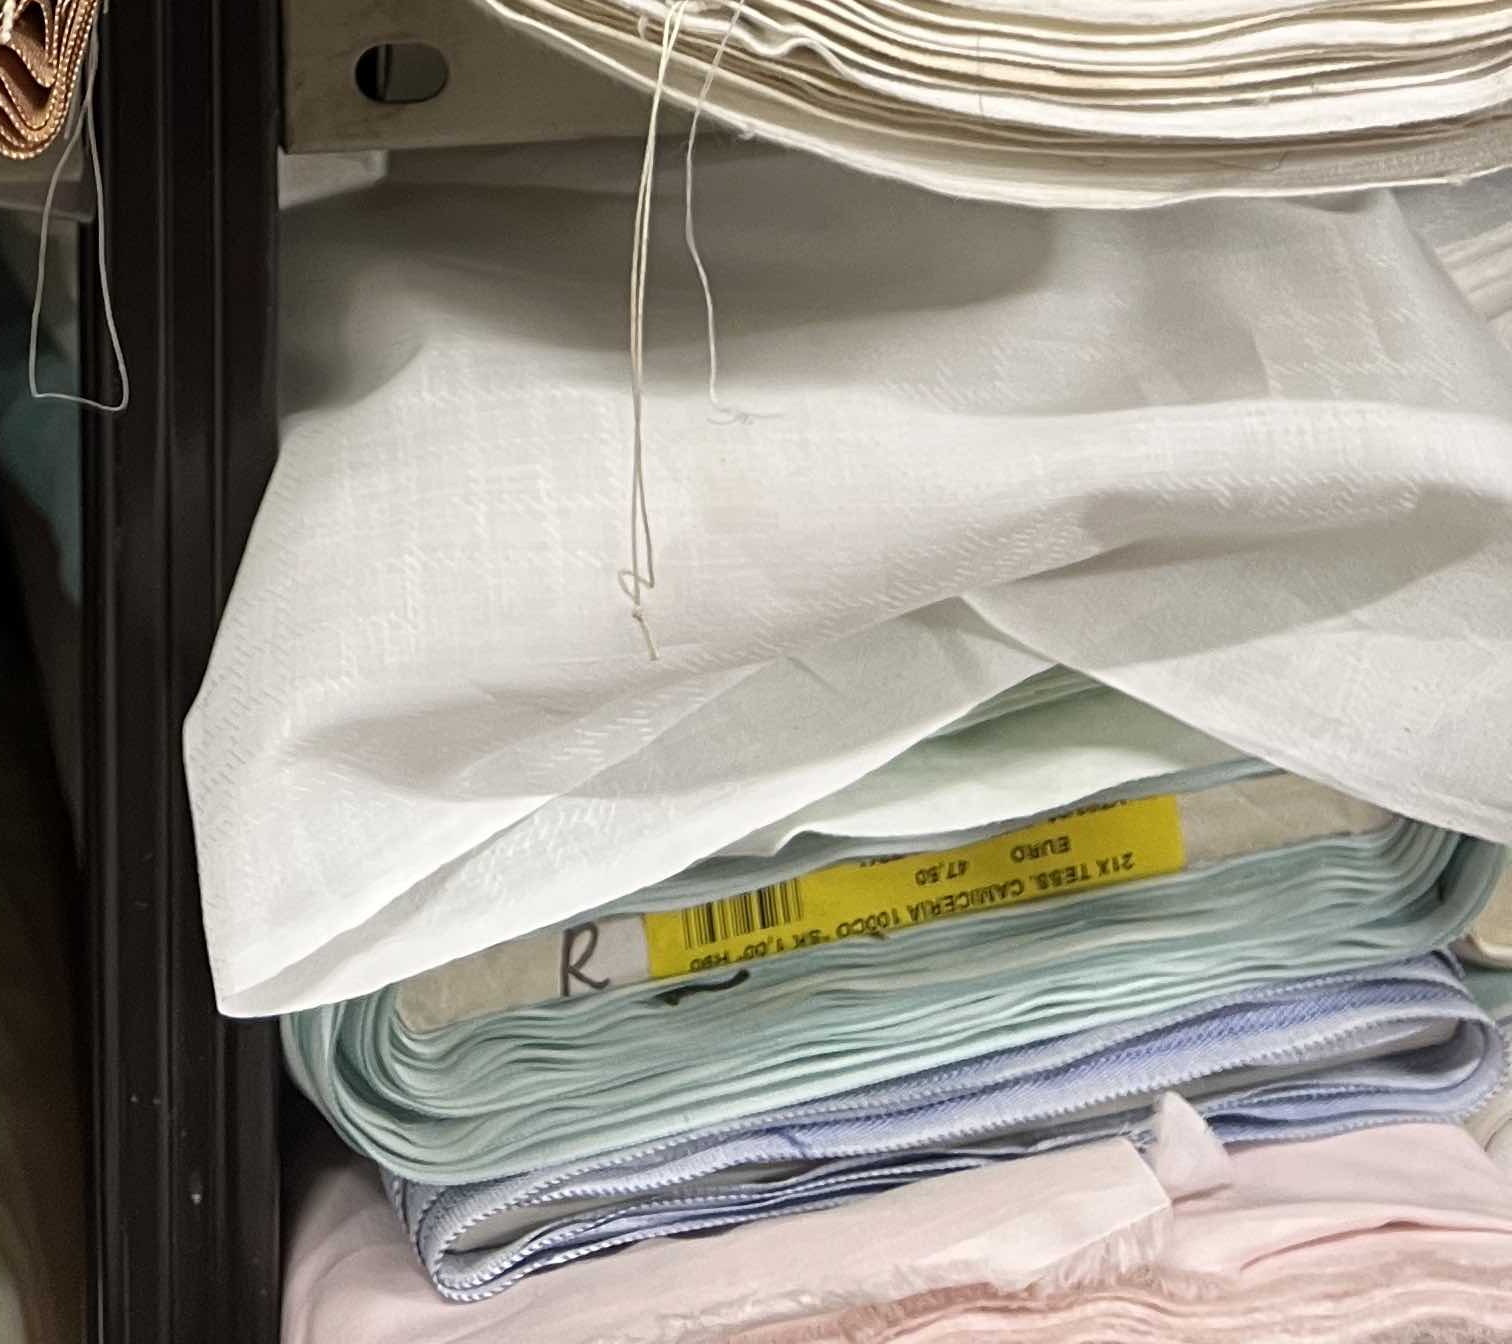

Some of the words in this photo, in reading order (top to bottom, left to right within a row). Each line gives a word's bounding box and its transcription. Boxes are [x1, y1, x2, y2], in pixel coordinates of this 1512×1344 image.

[1010, 836, 1072, 864] EURO
[907, 878, 1025, 922] CAMICERIA
[560, 920, 611, 997] R
